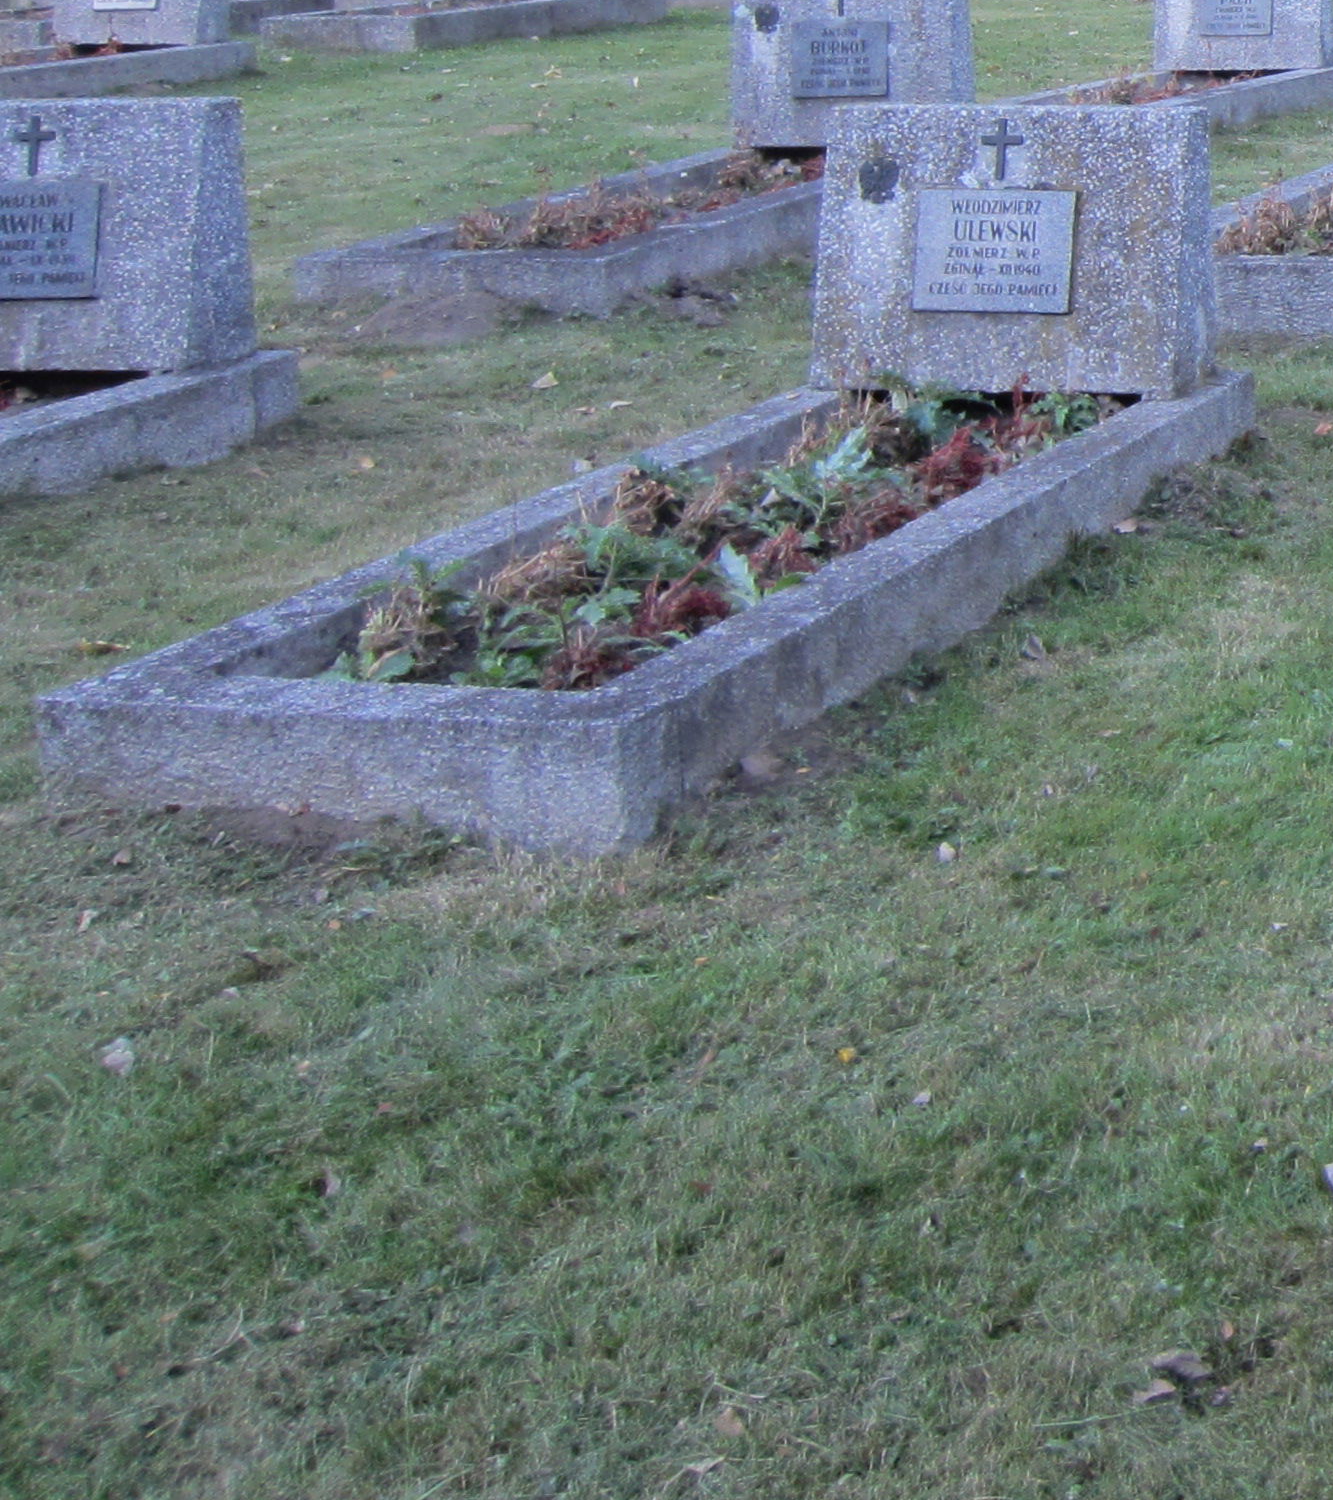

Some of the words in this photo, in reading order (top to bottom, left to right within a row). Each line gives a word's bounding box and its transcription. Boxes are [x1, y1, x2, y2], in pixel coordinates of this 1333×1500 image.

[951, 199, 1042, 215] WŁODZIMIERZ
[954, 219, 1038, 242] ULEWSKI
[974, 282, 1003, 297] JEGO
